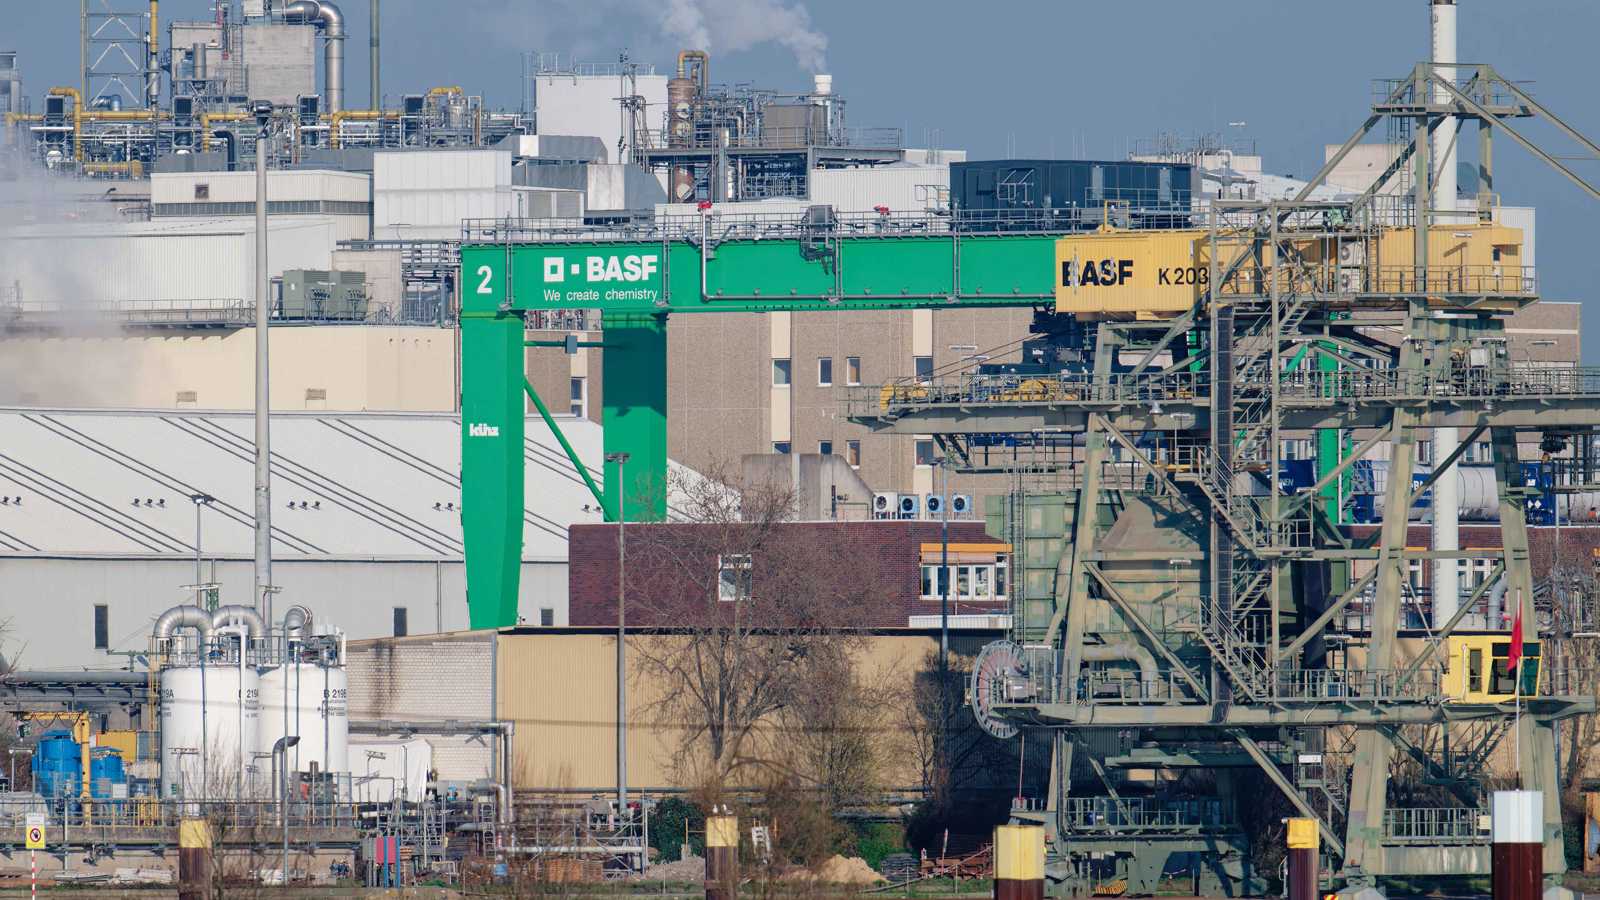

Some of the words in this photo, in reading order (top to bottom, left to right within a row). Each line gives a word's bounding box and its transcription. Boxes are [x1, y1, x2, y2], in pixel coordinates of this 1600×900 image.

[477, 265, 493, 294] 2
[586, 255, 658, 282] BASF
[1062, 260, 1134, 287] BASF
[1158, 268, 1171, 285] K
[1174, 267, 1209, 285] 203
[544, 289, 561, 302] We
[566, 289, 600, 301] create
[605, 288, 658, 303] chemistry
